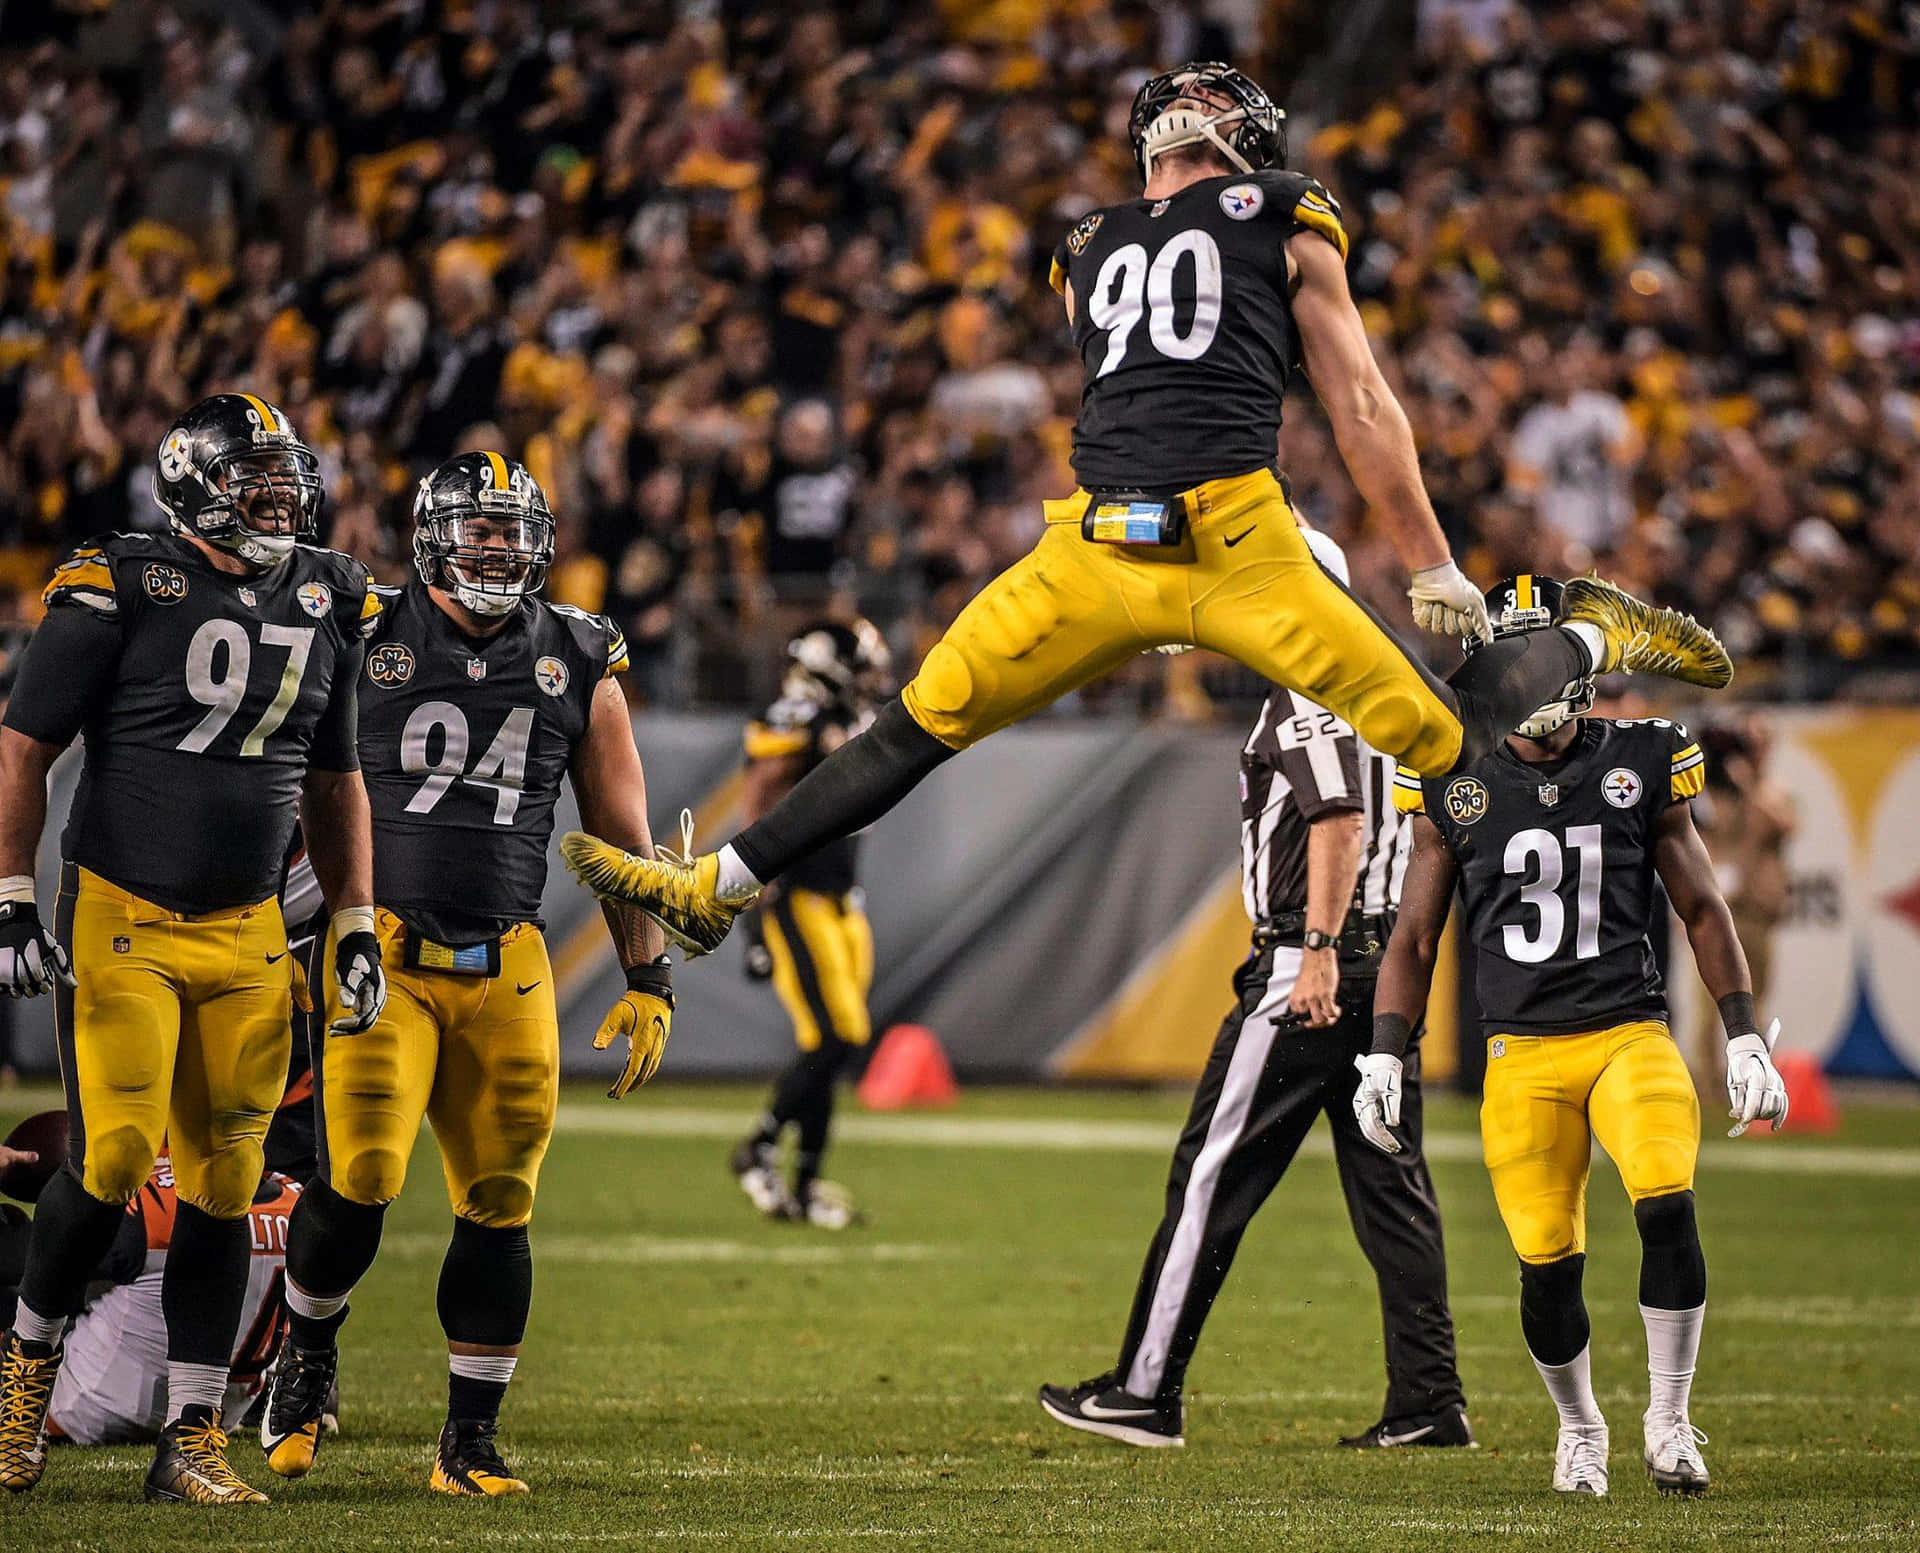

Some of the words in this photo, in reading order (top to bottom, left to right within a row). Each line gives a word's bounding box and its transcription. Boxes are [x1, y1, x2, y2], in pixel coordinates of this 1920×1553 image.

[1088, 228, 1223, 379] 90
[480, 465, 523, 493] 94
[1503, 585, 1541, 611] 31
[175, 618, 316, 758] 97
[1293, 711, 1340, 742] 52
[400, 700, 536, 826] 94
[1501, 823, 1603, 964] 31
